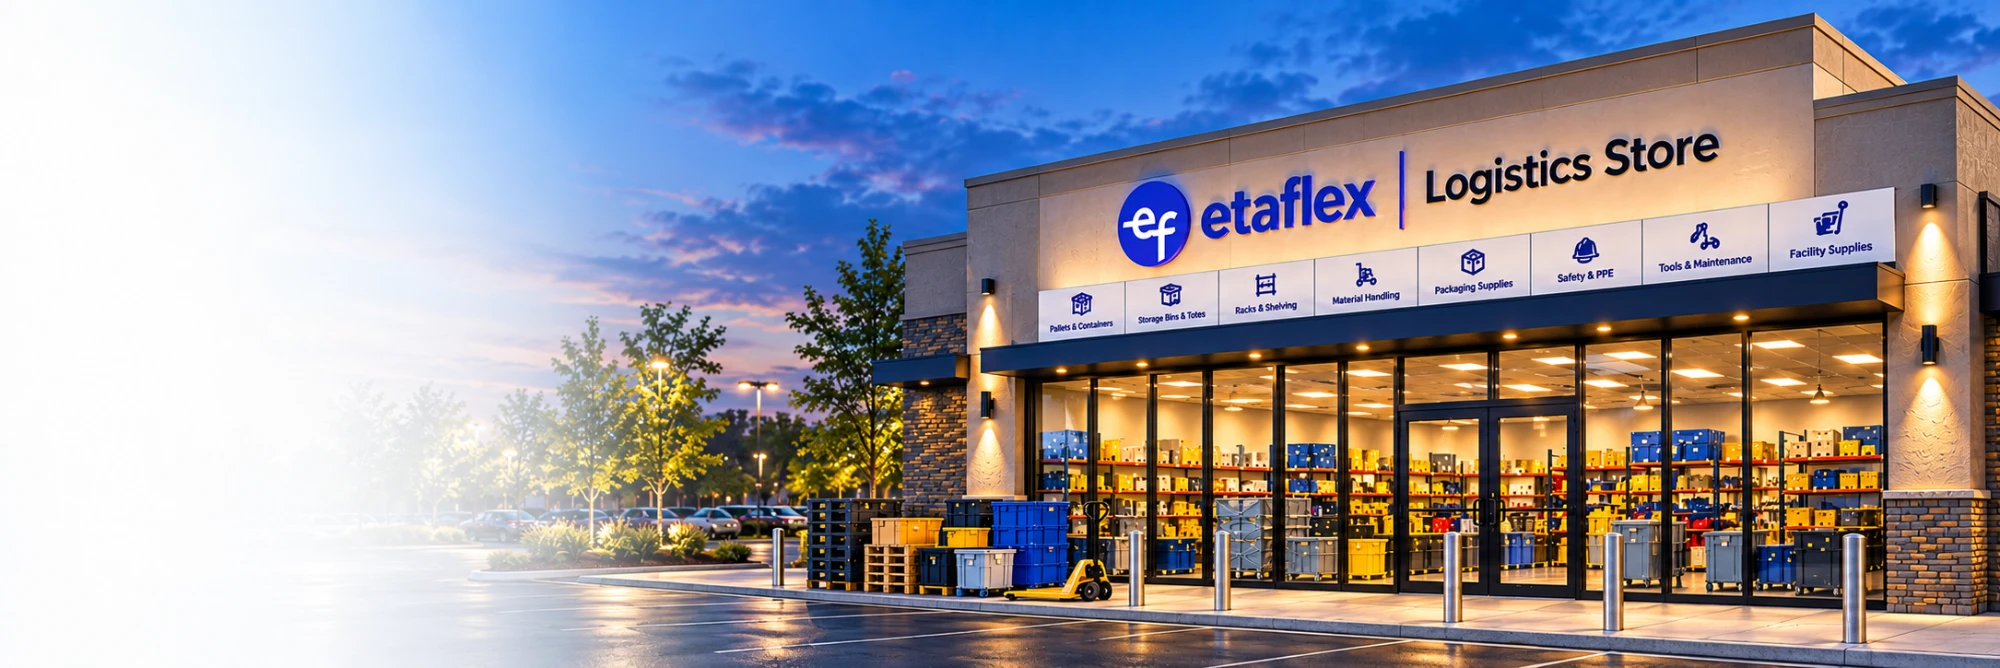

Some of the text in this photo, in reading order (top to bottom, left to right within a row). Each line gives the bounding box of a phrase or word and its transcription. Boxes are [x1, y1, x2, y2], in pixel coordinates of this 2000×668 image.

[1426, 132, 1720, 205] Logistics Store
[1200, 174, 1376, 239] etaflex
[1789, 242, 1873, 259] Facility Supplies
[1659, 255, 1752, 273] Tools & Maintenance
[1557, 269, 1614, 283] Safety & PPE
[1434, 279, 1514, 295] Packaging Supplies
[1332, 291, 1401, 305] Material Handling
[1235, 301, 1298, 314] Racks & Shelving
[1138, 310, 1206, 325] Storage Bins & Totes
[1050, 319, 1113, 333] Pallets & Containers
